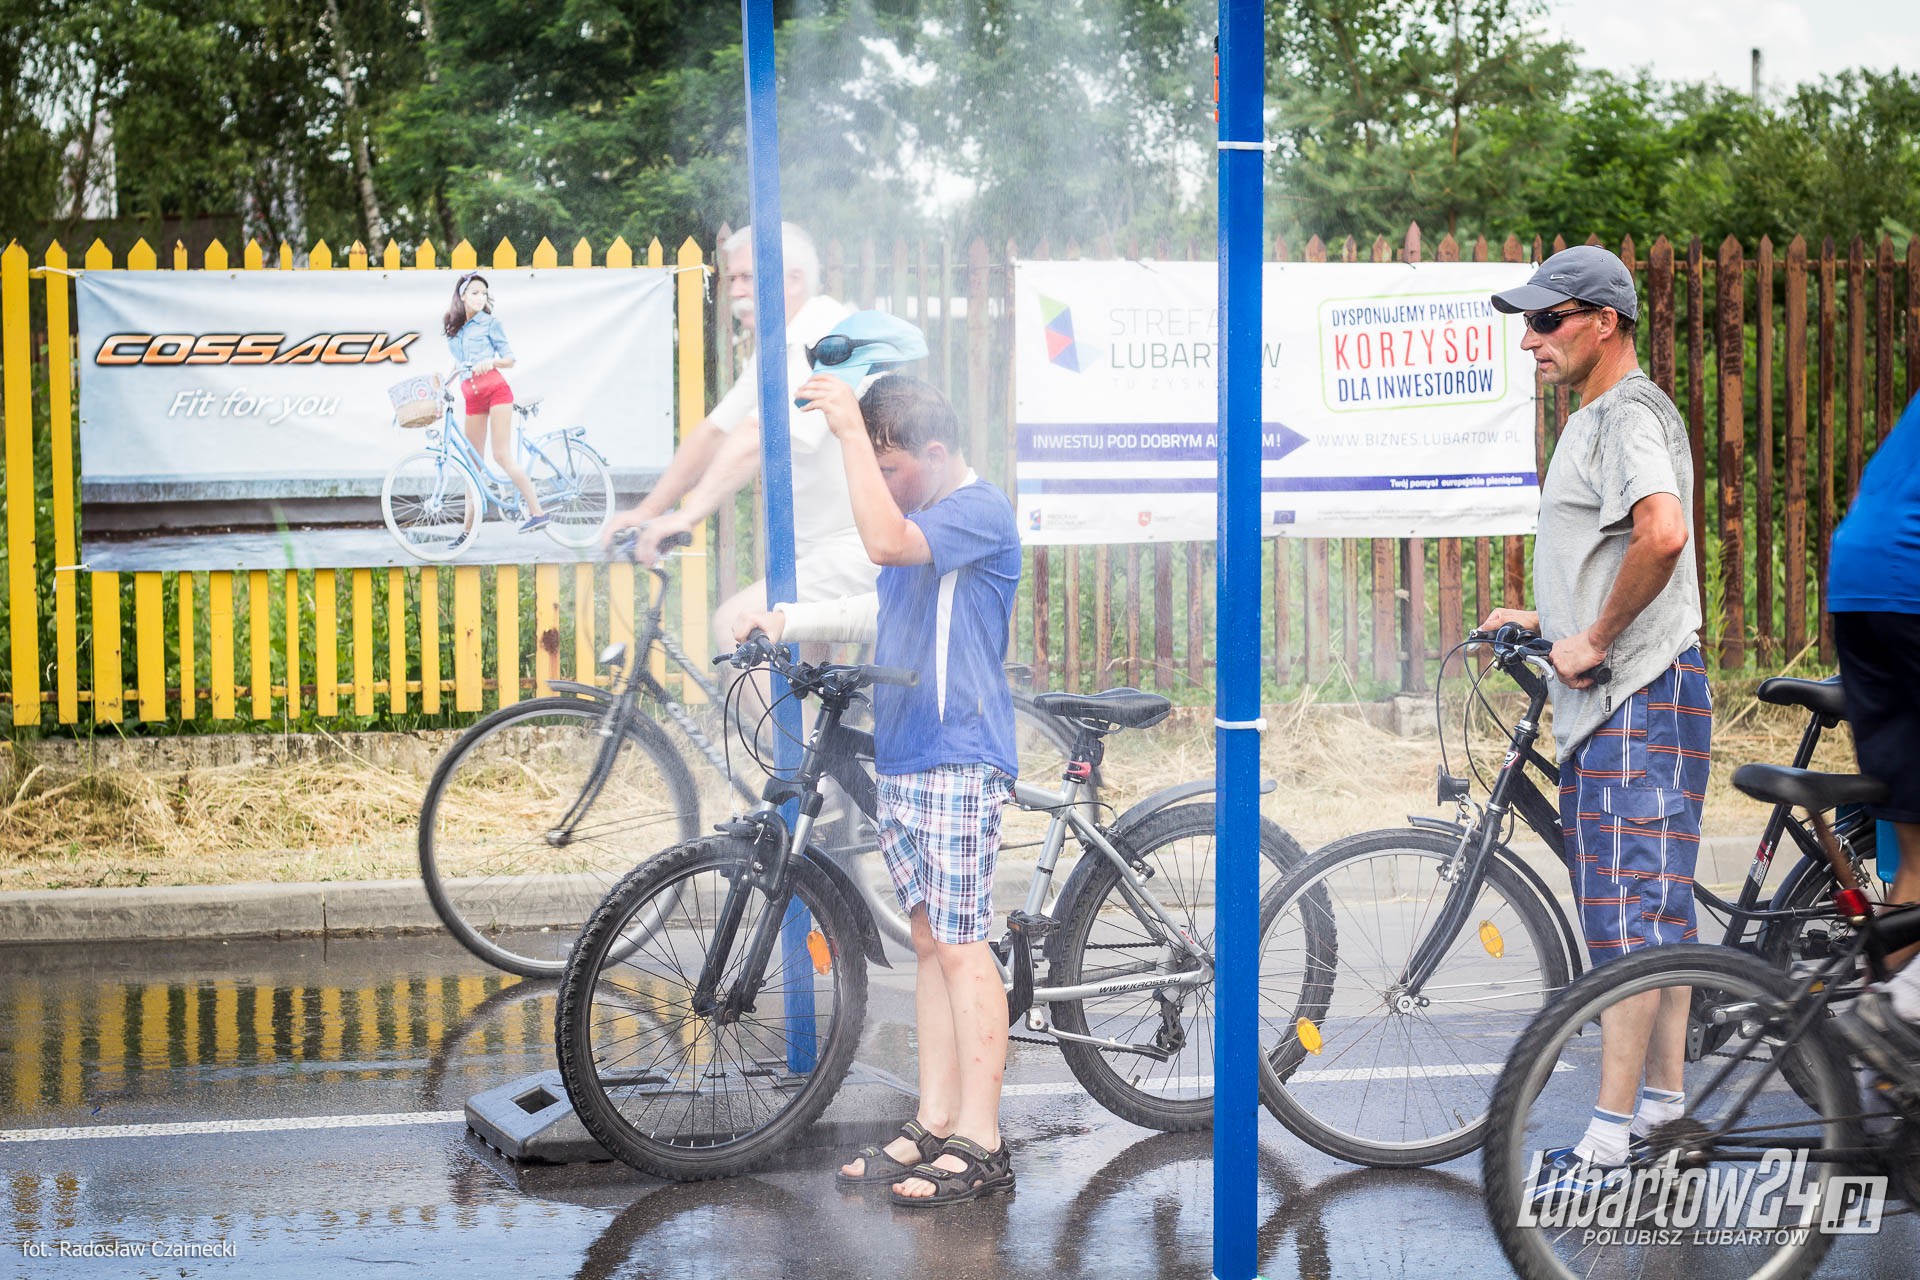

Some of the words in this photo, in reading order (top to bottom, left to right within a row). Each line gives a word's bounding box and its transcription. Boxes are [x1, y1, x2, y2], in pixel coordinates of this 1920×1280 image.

[1332, 305, 1425, 326] DYSPONUJEMY
[1430, 301, 1493, 320] PAKIETEM
[95, 332, 420, 366] COSSACK
[1111, 343, 1281, 369] LUBARW
[1335, 320, 1492, 370] KORZYŚCI
[1338, 378, 1371, 402] DLA
[1377, 365, 1493, 400] INWESTORÓW
[168, 388, 212, 418] Fit
[220, 386, 270, 418] for
[269, 396, 342, 424] you
[1033, 435, 1103, 449] INWESTUJ
[1108, 434, 1137, 448] POD
[1141, 433, 1202, 448] DOBRYM
[1099, 976, 1182, 994] WWW.KROSS.EU
